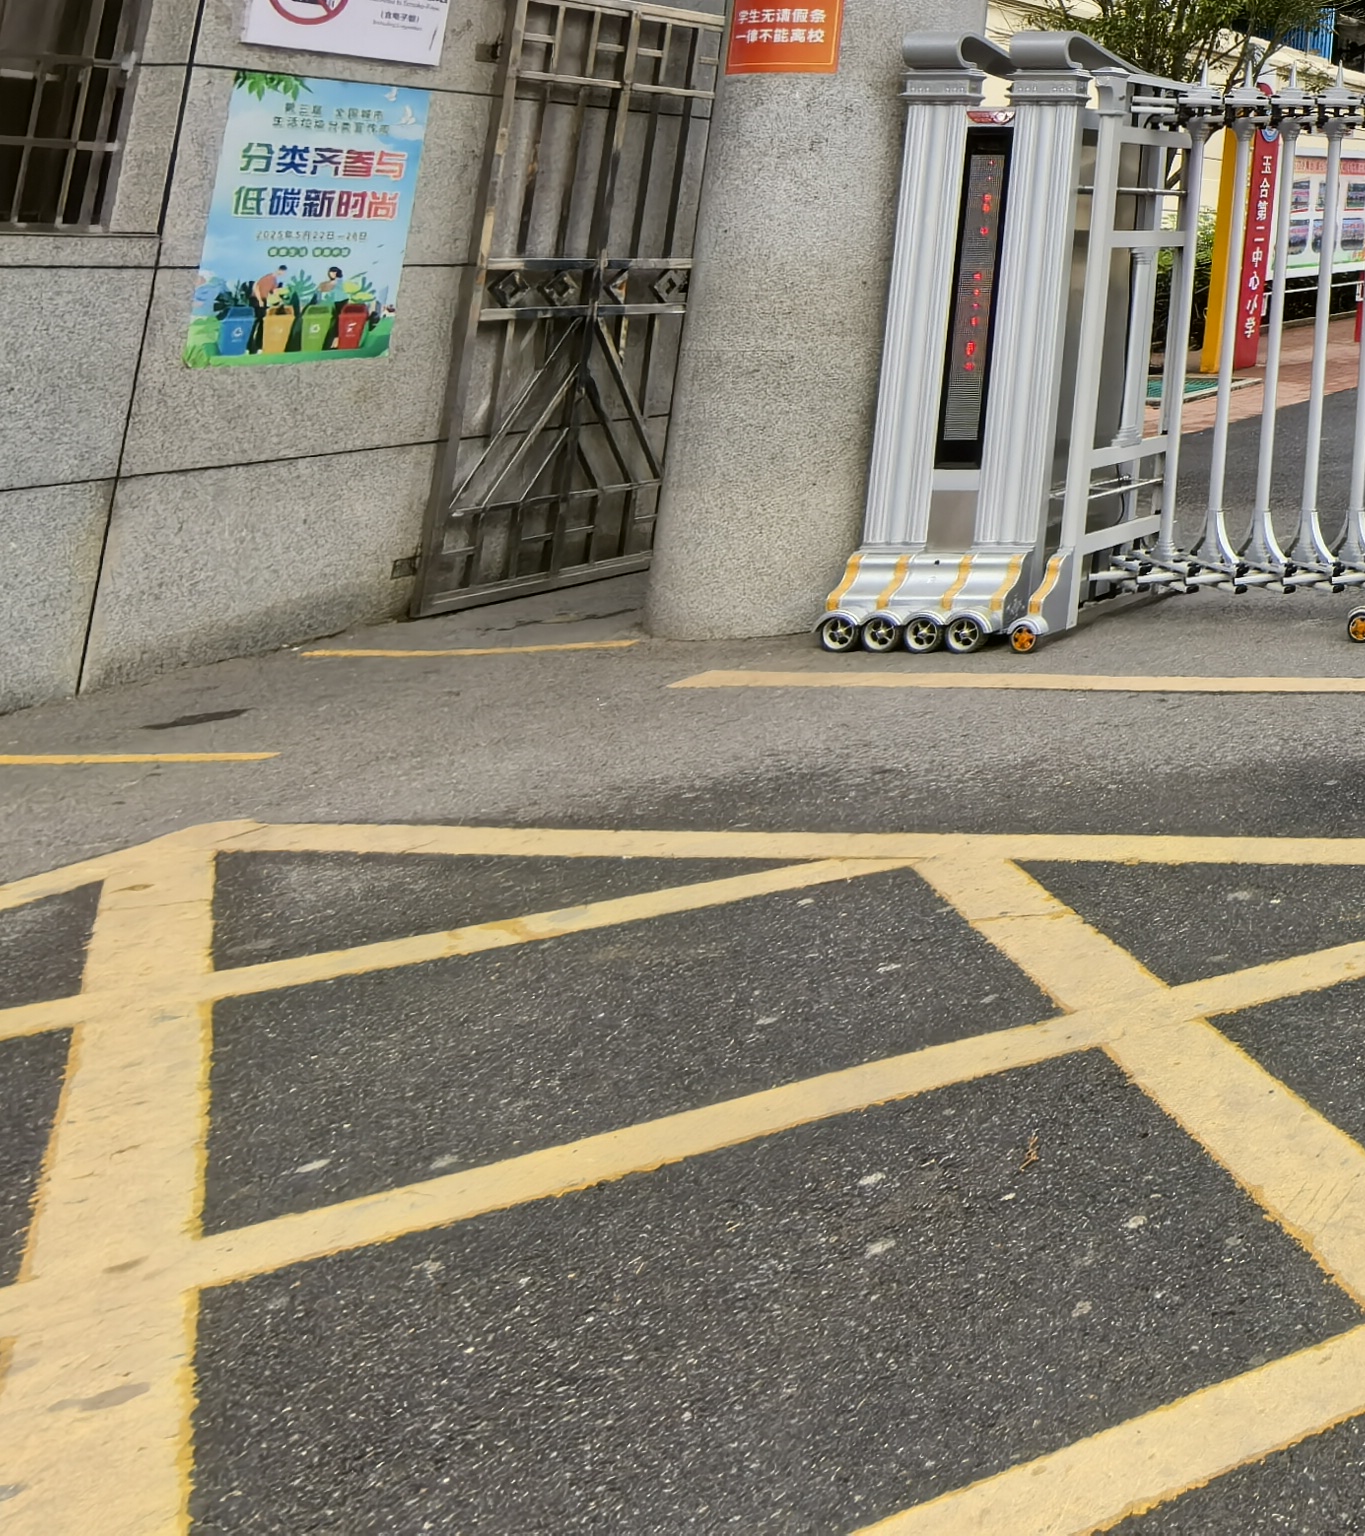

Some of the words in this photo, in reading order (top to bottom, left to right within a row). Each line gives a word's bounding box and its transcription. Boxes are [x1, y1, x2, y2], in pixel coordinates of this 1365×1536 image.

[738, 8, 826, 24] 学生无请假条
[735, 28, 825, 44] 一律不能离校
[238, 142, 409, 182] 分类齐参与
[232, 185, 400, 221] 低碳新时尚
